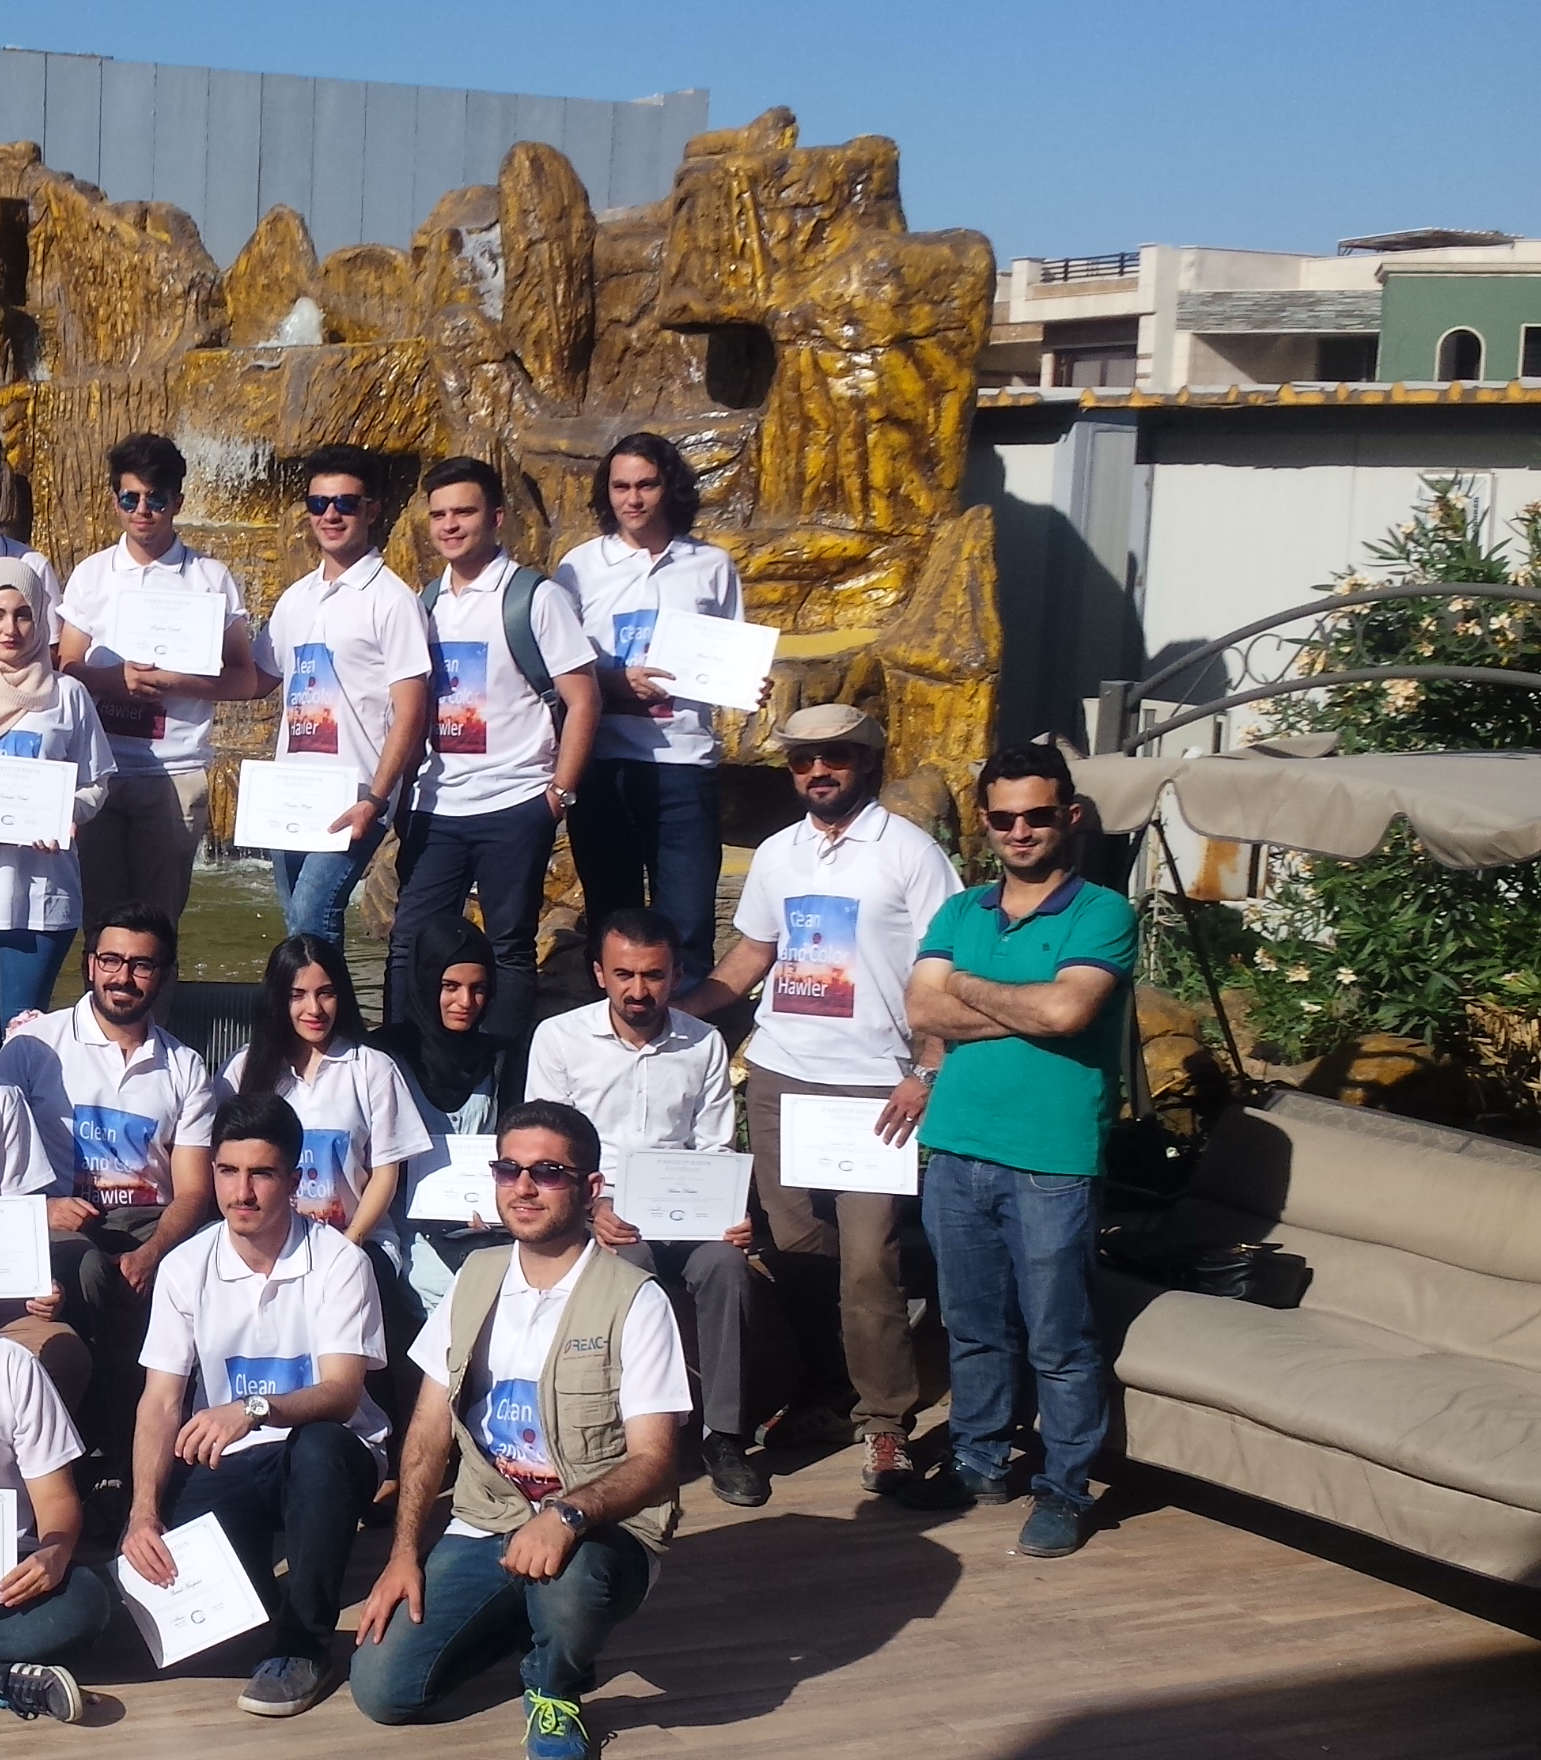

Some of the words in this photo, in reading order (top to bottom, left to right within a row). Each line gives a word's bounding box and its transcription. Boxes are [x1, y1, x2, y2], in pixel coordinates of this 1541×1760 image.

[781, 944, 807, 963] and
[778, 976, 828, 998] Hawler
[79, 1120, 116, 1143] Clean
[81, 1186, 134, 1206] Hawler
[236, 1373, 277, 1396] Clean
